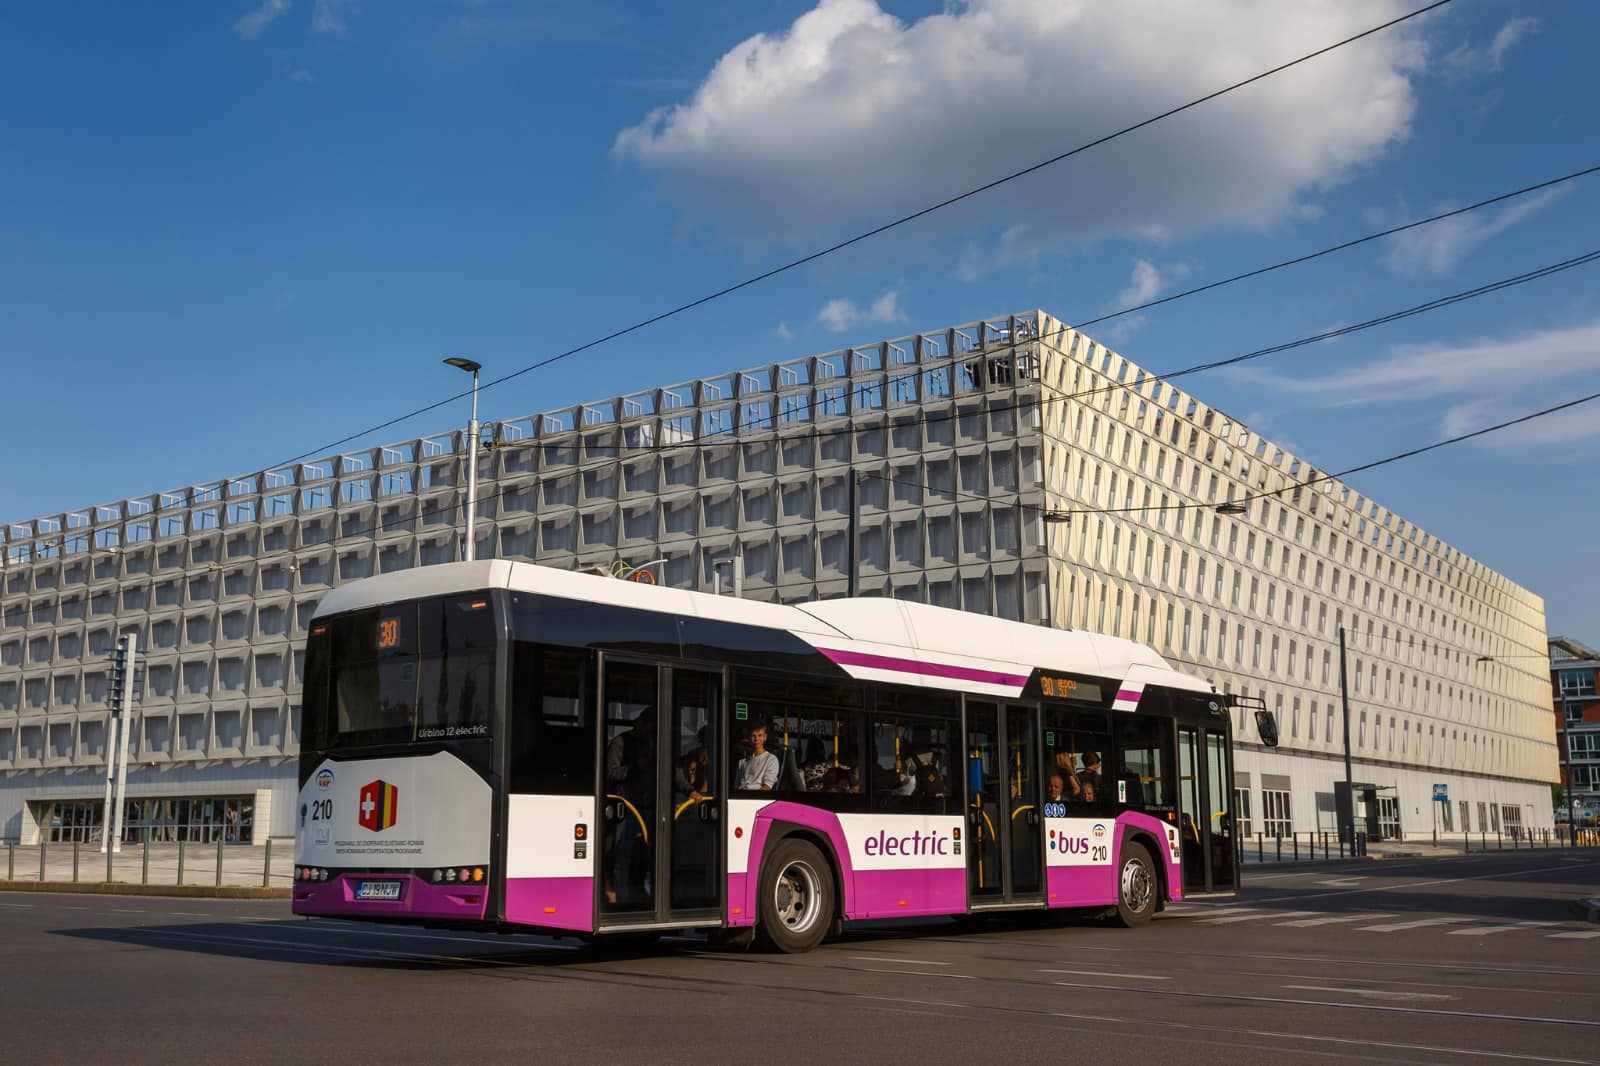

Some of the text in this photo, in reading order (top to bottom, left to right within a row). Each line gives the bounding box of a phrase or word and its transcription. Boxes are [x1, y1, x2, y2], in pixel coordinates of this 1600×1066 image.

[379, 620, 397, 647] 30
[1041, 676, 1054, 696] 30
[419, 724, 488, 738] Urbino 12 electric
[312, 799, 333, 820] 210
[864, 829, 948, 856] electric
[1058, 831, 1089, 854] bus
[1092, 845, 1107, 861] 210
